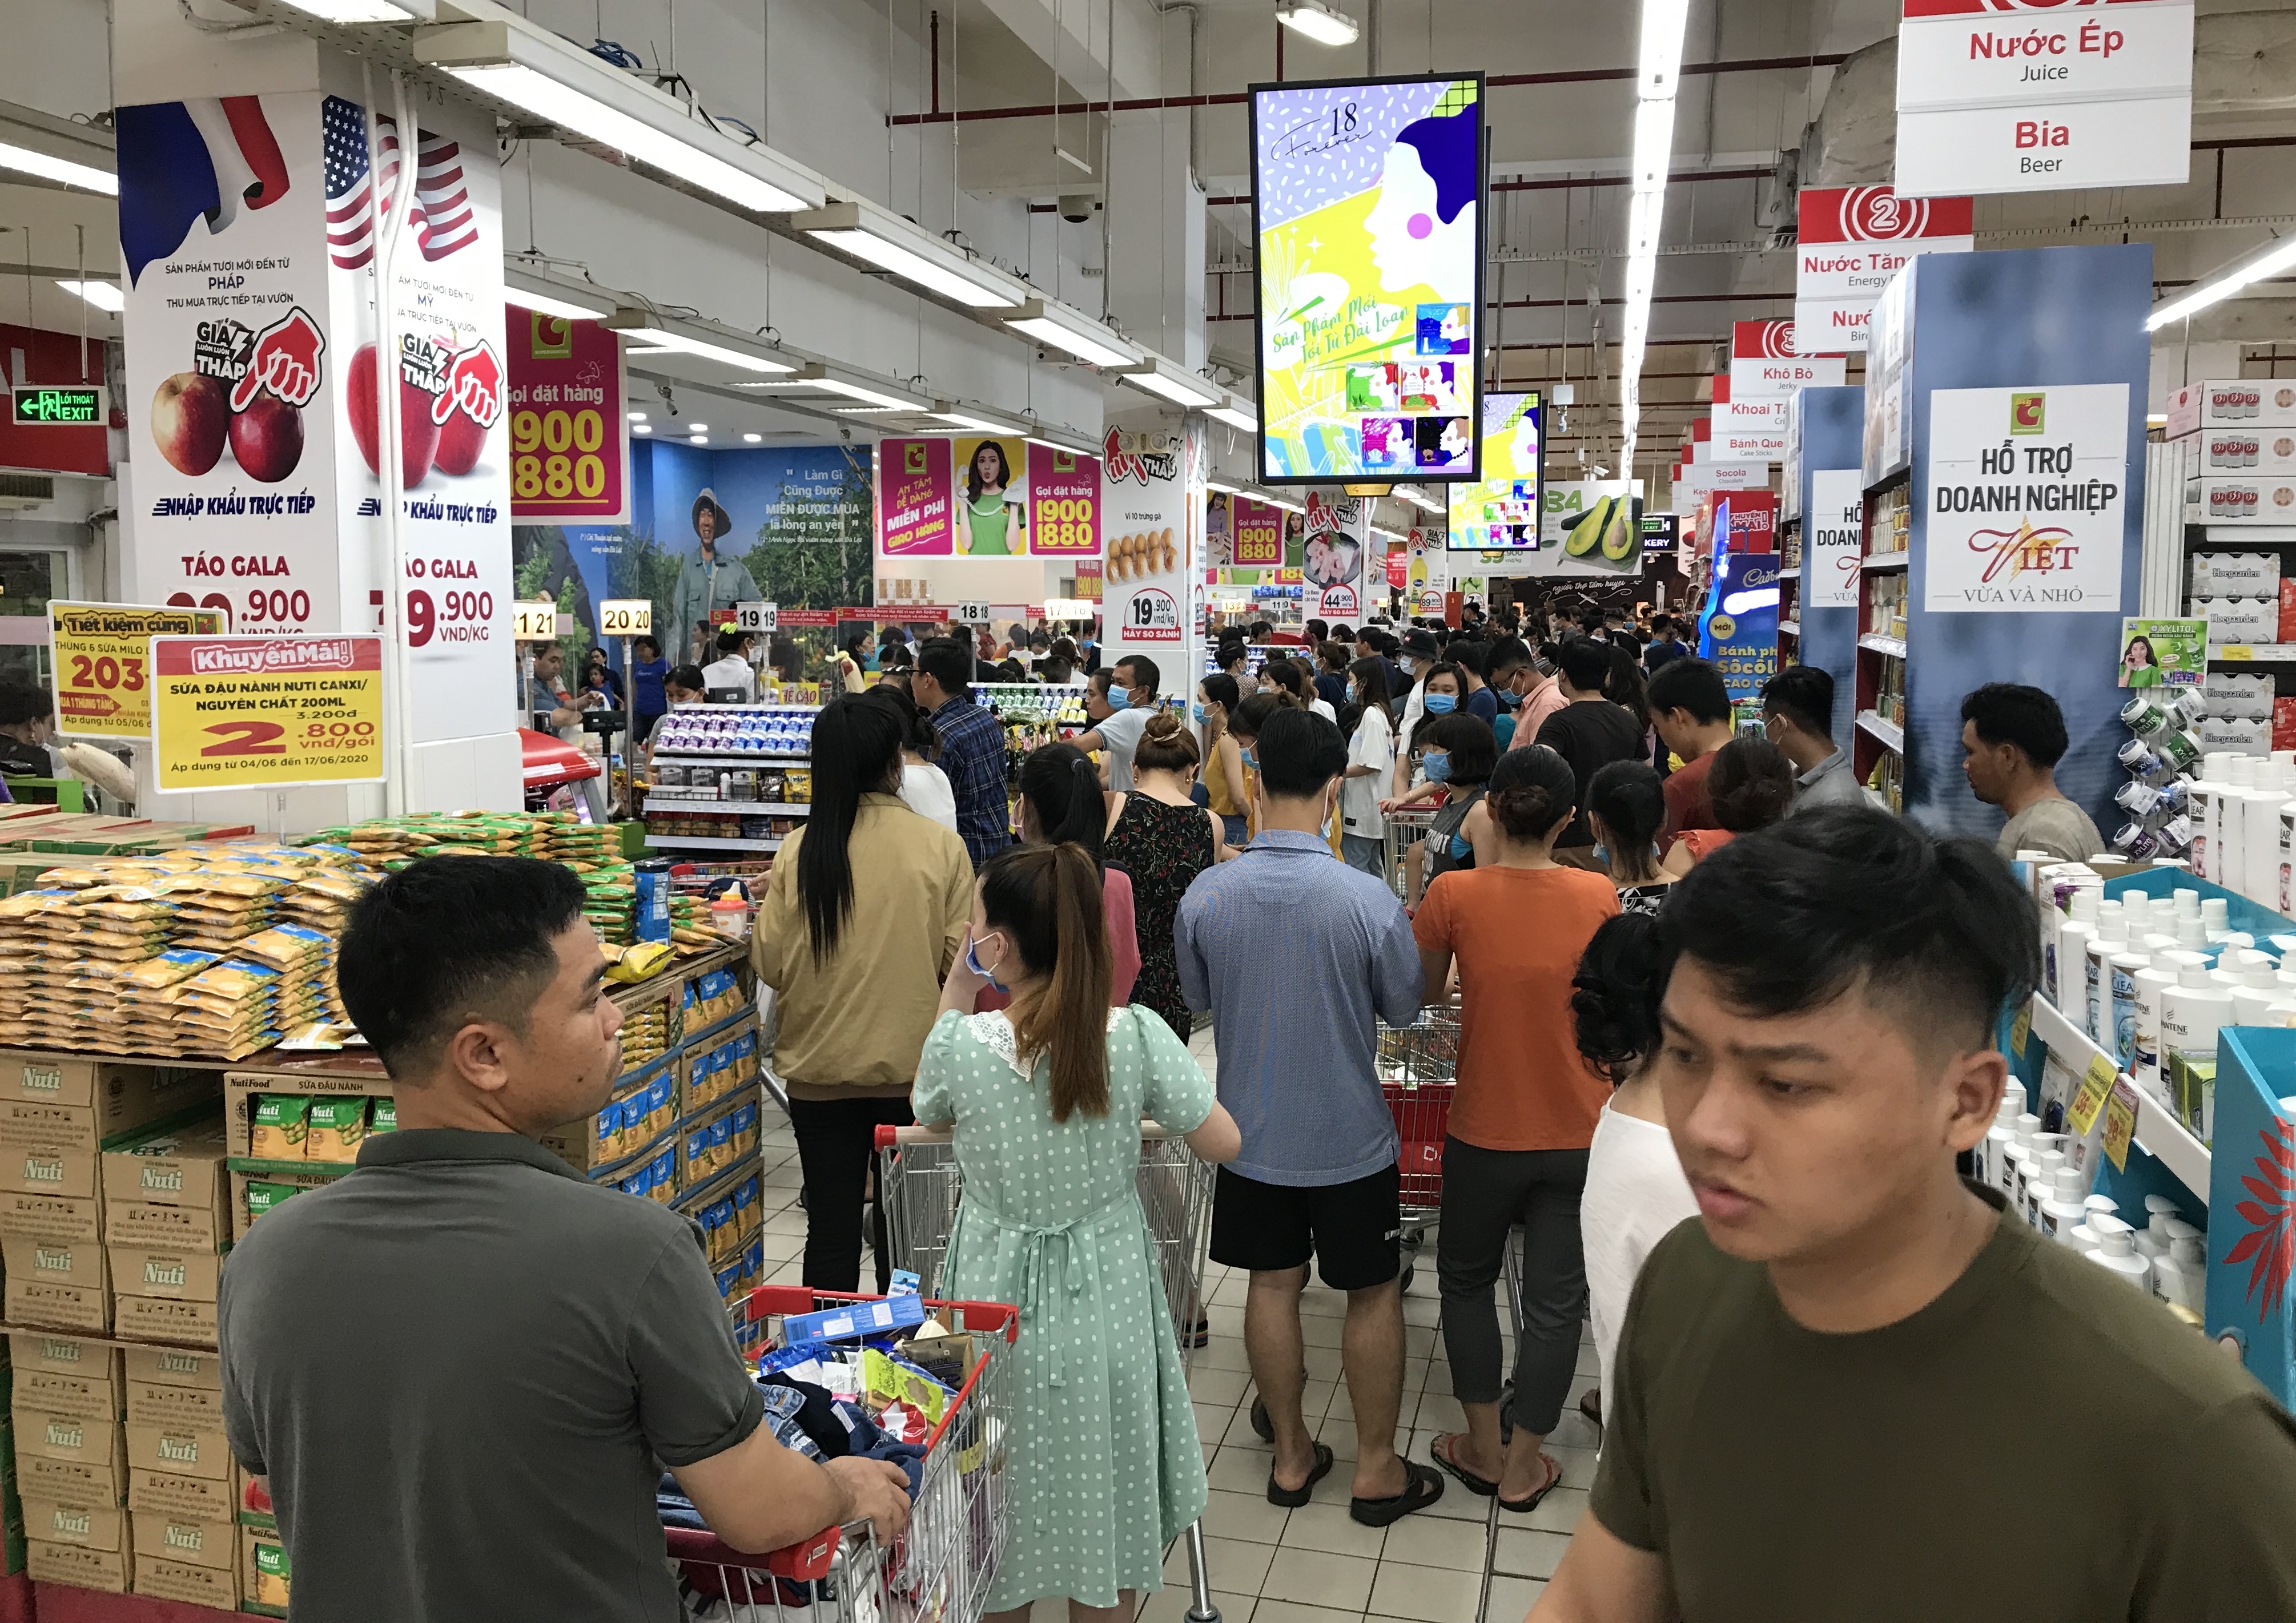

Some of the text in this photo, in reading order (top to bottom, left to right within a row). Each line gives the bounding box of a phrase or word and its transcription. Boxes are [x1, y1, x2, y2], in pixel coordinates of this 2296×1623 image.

[1970, 19, 2124, 60] Nước Ép
[2020, 65, 2068, 82] Juice
[1331, 103, 1357, 136] 18
[1270, 119, 1373, 162] Forever
[2016, 121, 2070, 148] Bia
[2020, 157, 2063, 174] Beer
[1868, 194, 1900, 232] 2
[166, 257, 290, 274] SẢN PHẨM TƯƠI MỚI ĐẾN TỪ
[1805, 255, 1861, 273] Nước
[208, 273, 244, 290] PHÁP
[1848, 276, 1888, 288] Energy
[167, 292, 293, 308] THU MUA TRỰC TIẾP TẠI VƯỜN
[417, 292, 433, 308] MỸ
[1376, 307, 1410, 332] Loan
[197, 318, 230, 344] GIÁ
[403, 333, 433, 359] GIÁ
[1763, 367, 1813, 379] Khô Bò
[533, 384, 603, 405] đặt hàng
[1778, 382, 1798, 391] Jerky
[73, 393, 94, 404] THOÁT
[62, 407, 93, 420] EXIT
[1731, 403, 1770, 414] Khoai
[1730, 438, 1783, 448] Bánh Que
[1982, 440, 2073, 478] HỖ TRỢ
[805, 469, 843, 480] Làm Gì
[1716, 469, 1746, 477] Socola
[784, 485, 843, 498] Cũng Được
[898, 476, 932, 497] AN TÂM
[1036, 485, 1093, 498] Gọi đặt hàng
[163, 486, 315, 521] NHẬP KHẨU TRỰC TIẾP
[910, 489, 933, 505] DÀNG
[1936, 478, 2117, 516] DOANH NGHIỆP
[797, 503, 830, 516] ĐƯỢC
[834, 502, 859, 514] MÙA
[887, 496, 945, 531] MIỄN PHÍ
[1036, 499, 1092, 522] 1900
[1139, 512, 1153, 521] trứng
[1155, 512, 1161, 521] gà
[783, 517, 806, 531] lòng
[825, 519, 844, 532] yên
[887, 519, 945, 549] GIAO HÀNG
[1036, 522, 1093, 546] 1880
[1239, 528, 1276, 543] 1900
[1239, 543, 1276, 558] 1880
[1968, 526, 2079, 583] VIỆT
[182, 550, 290, 576] TÁO GALA
[431, 558, 478, 579] GALA
[2212, 569, 2260, 578] Hoegaarden
[1325, 594, 1340, 607] 44
[1963, 585, 2084, 603] VỪA VÀ NHỎ
[242, 589, 310, 622] .900
[961, 606, 977, 618] 18
[980, 606, 988, 618] 18
[1133, 598, 1171, 625] 19 .900
[68, 615, 190, 636] Tiết kiệm cùng
[536, 613, 552, 633] 21
[605, 610, 629, 629] 20
[636, 611, 649, 629] 20
[740, 610, 759, 626] 19
[764, 611, 775, 626] 19
[1153, 615, 1175, 626] vnd/kg
[440, 624, 488, 643] VND/KG
[1156, 629, 1180, 638] SÁNH
[119, 645, 143, 654] MILO
[1718, 646, 1756, 656] Bánh
[71, 655, 144, 691] 203
[170, 679, 368, 696] SỮA ĐẬU NÀNH NUTI CANXI/
[1724, 678, 1750, 688] CAO
[797, 689, 817, 704] CÀO
[2207, 688, 2255, 698] Hoegaarden
[196, 695, 345, 711] NGUYÊN CHẤT 200ML
[80, 716, 144, 728] dụng 05/06
[296, 710, 357, 719] 3.200đ
[201, 721, 375, 757] 2 .800
[299, 736, 375, 750] vnđ/gói
[171, 754, 368, 773] Áp dụng từ 04/06 đến 17/06/2020
[21, 1068, 61, 1089] Nuti
[230, 1079, 363, 1091] NutiFood SỮA ĐẬU NÀNH
[312, 1106, 334, 1117] Nuti
[141, 1169, 182, 1190] Nuti
[157, 1438, 198, 1461] Nuti
